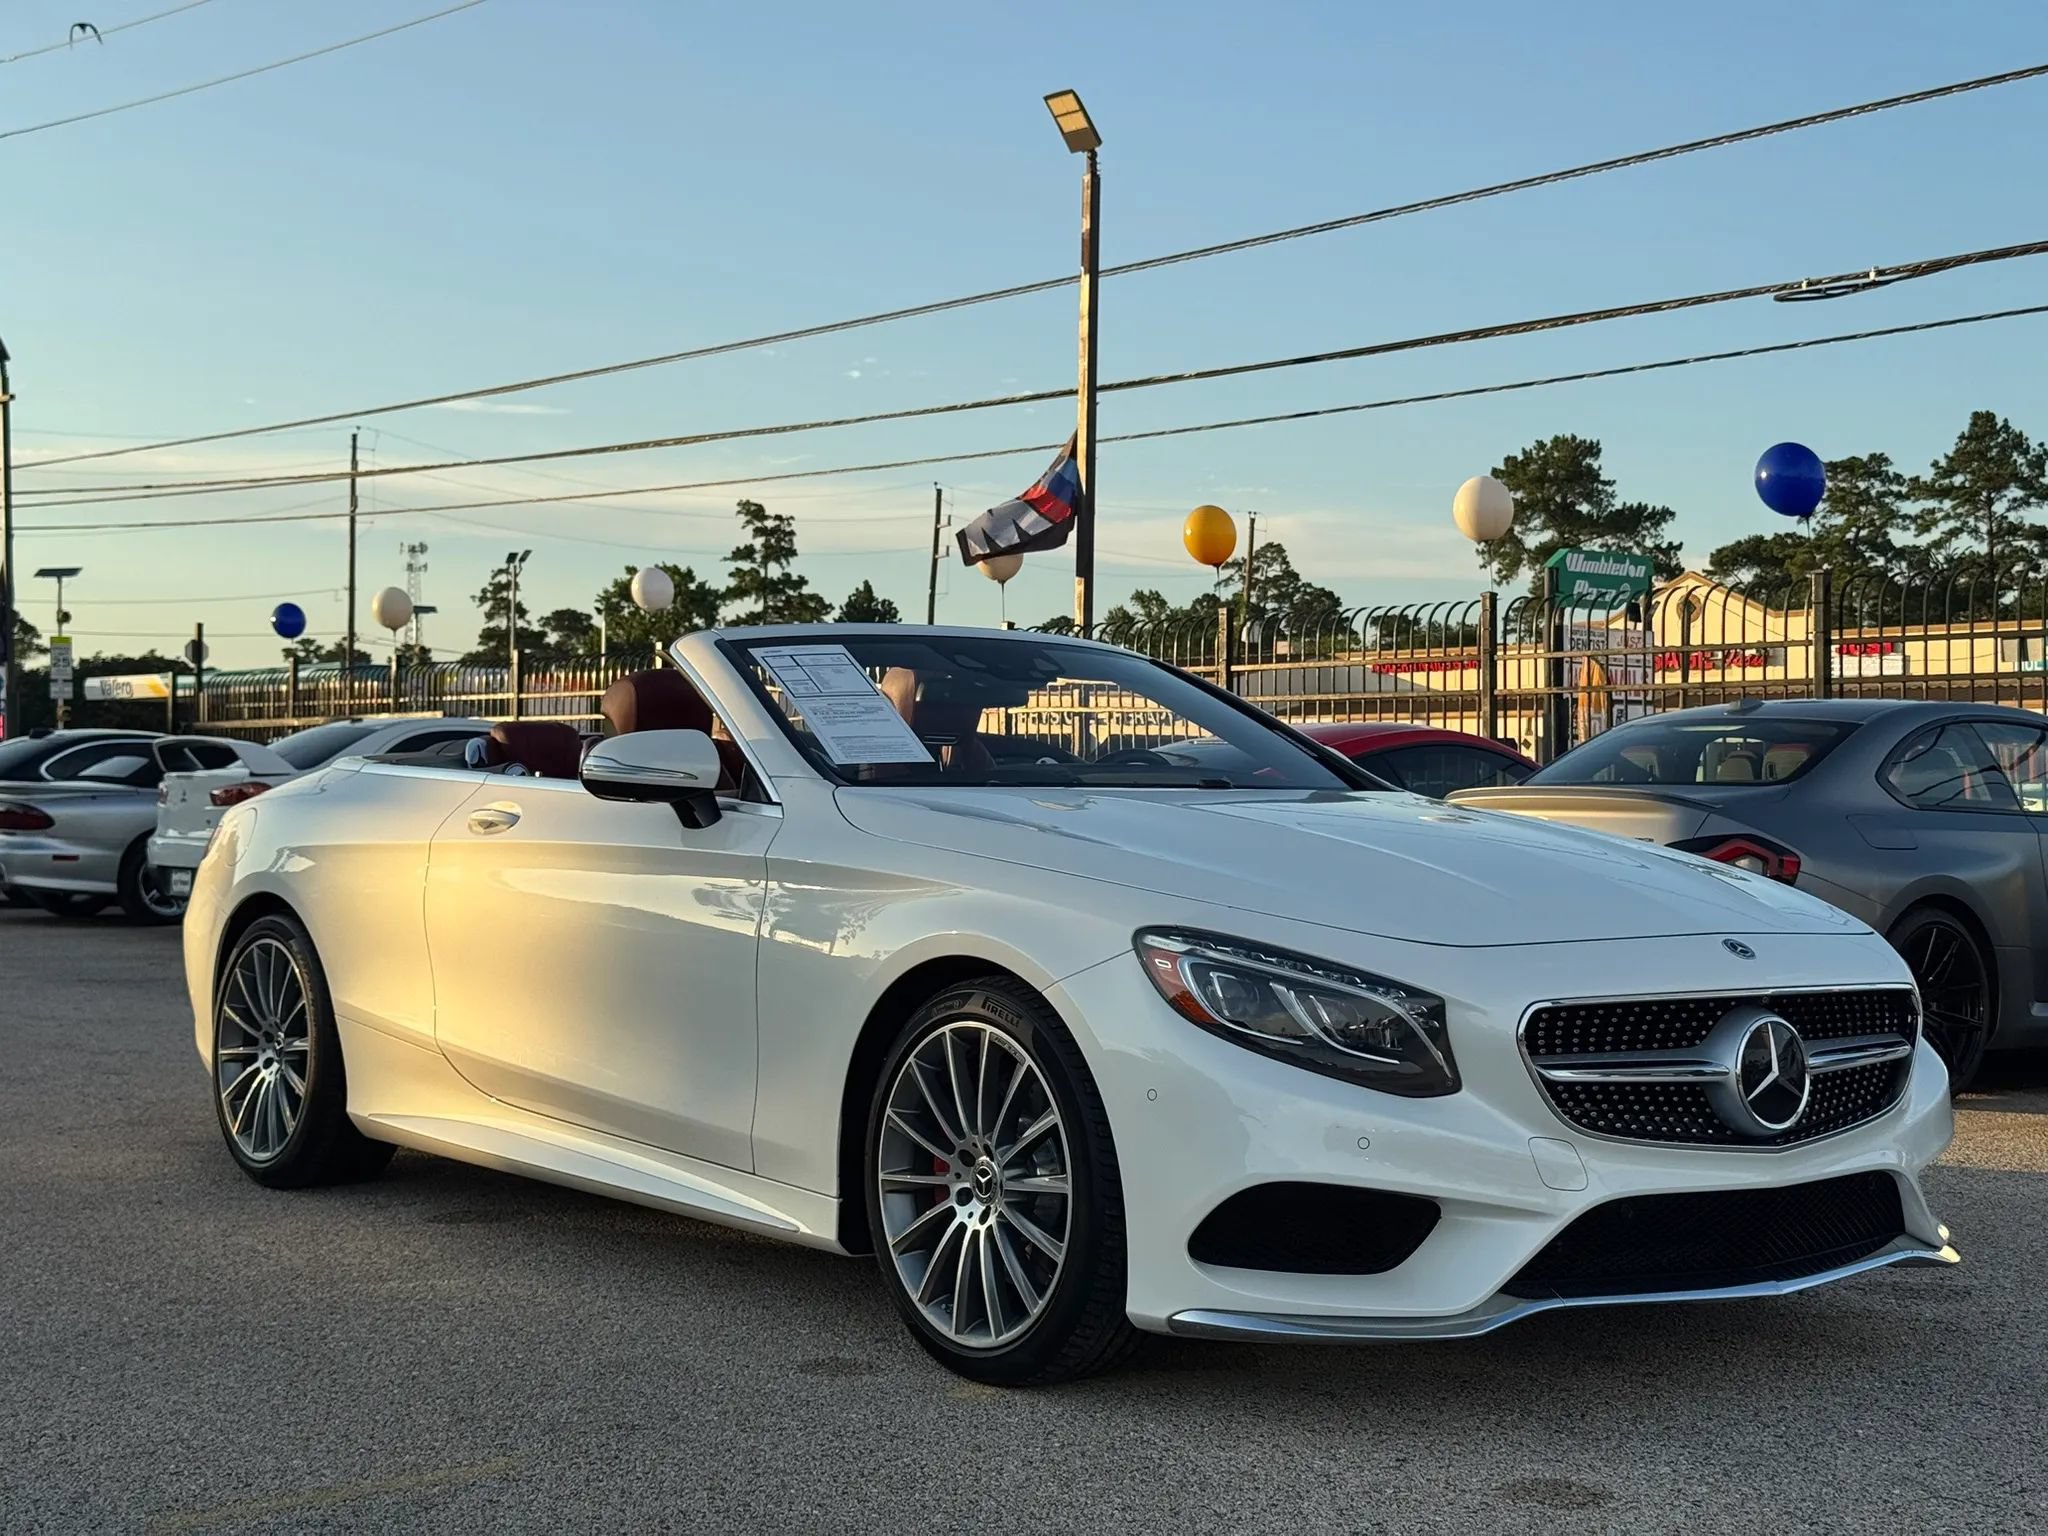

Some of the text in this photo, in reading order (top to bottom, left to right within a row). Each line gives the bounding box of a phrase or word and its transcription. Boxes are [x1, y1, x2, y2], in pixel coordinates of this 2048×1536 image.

[1565, 552, 1647, 579] Wimbledon
[1572, 579, 1617, 602] Plaza
[980, 996, 1024, 1029] PIRELLI
